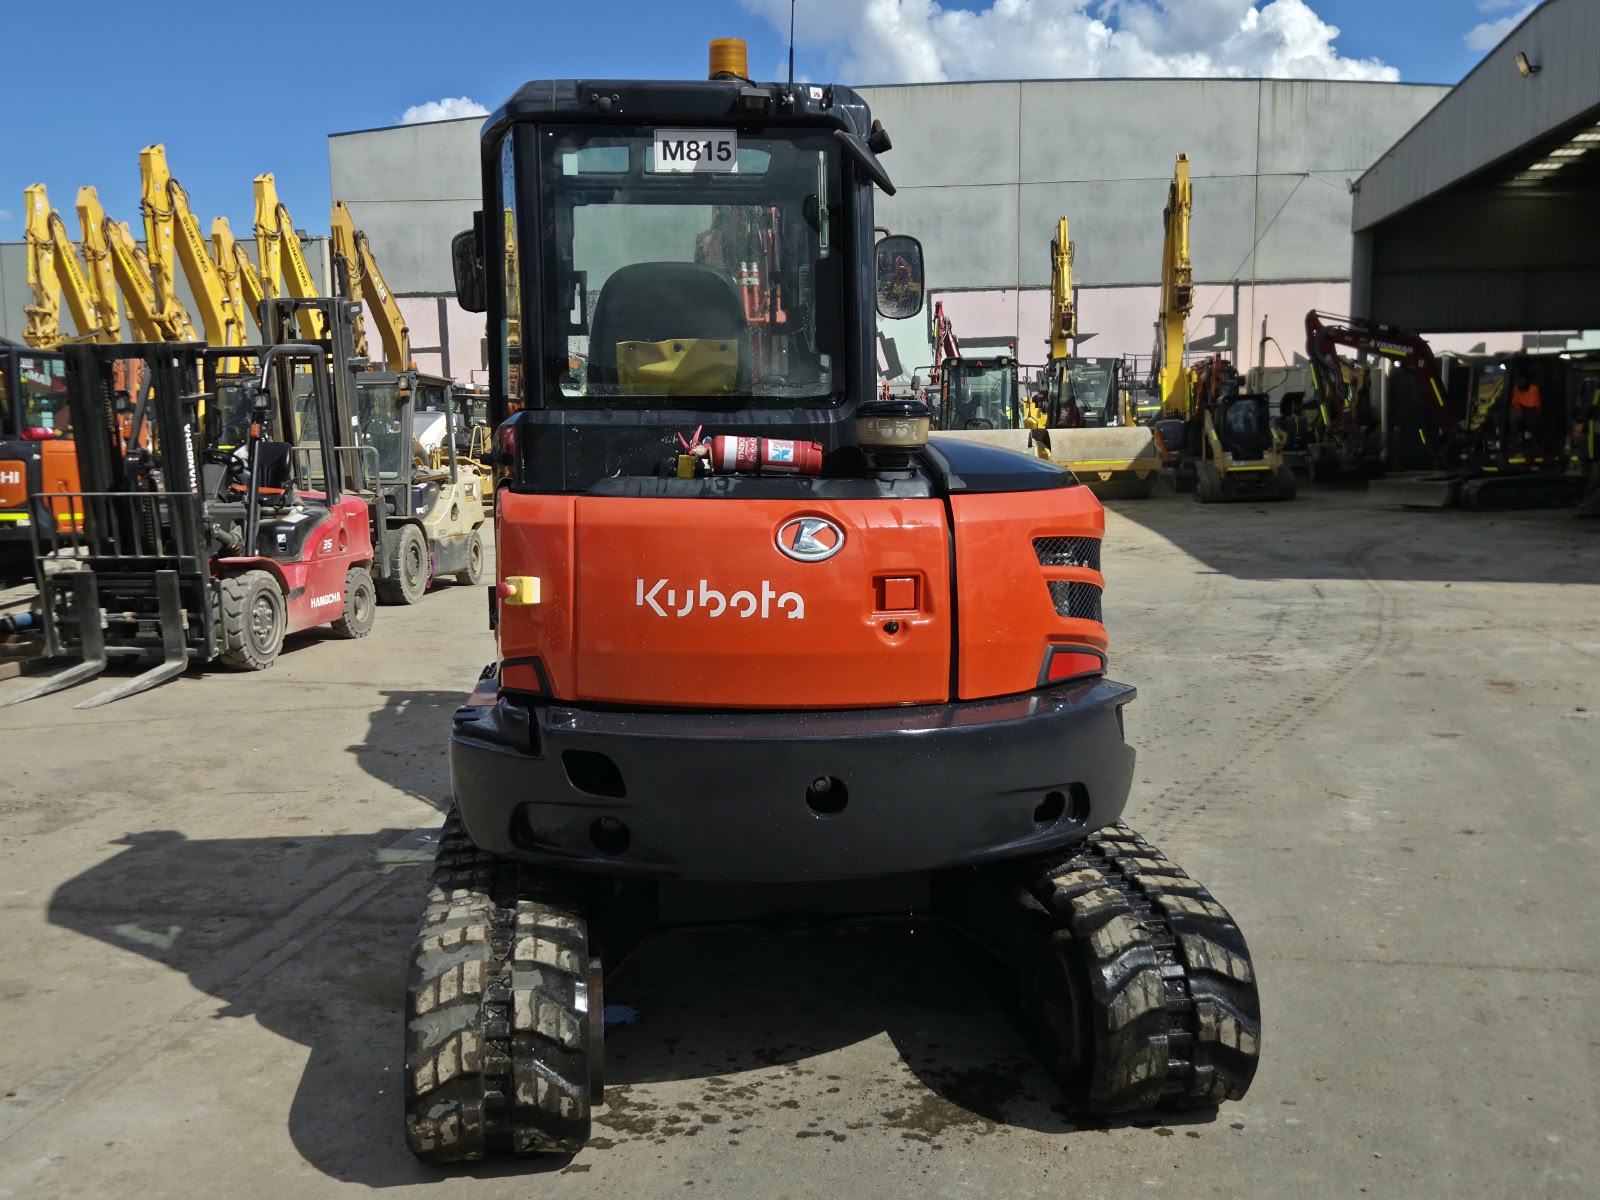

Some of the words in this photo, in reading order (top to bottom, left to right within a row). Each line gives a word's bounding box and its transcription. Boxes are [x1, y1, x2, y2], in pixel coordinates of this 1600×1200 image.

[662, 140, 732, 161] M815
[183, 216, 209, 273] SUMITOMO
[184, 423, 197, 488] HANGCHA
[0, 471, 20, 484] HI
[323, 539, 333, 550] 35
[310, 592, 341, 608] HANGCHA
[636, 578, 805, 619] Kubota
